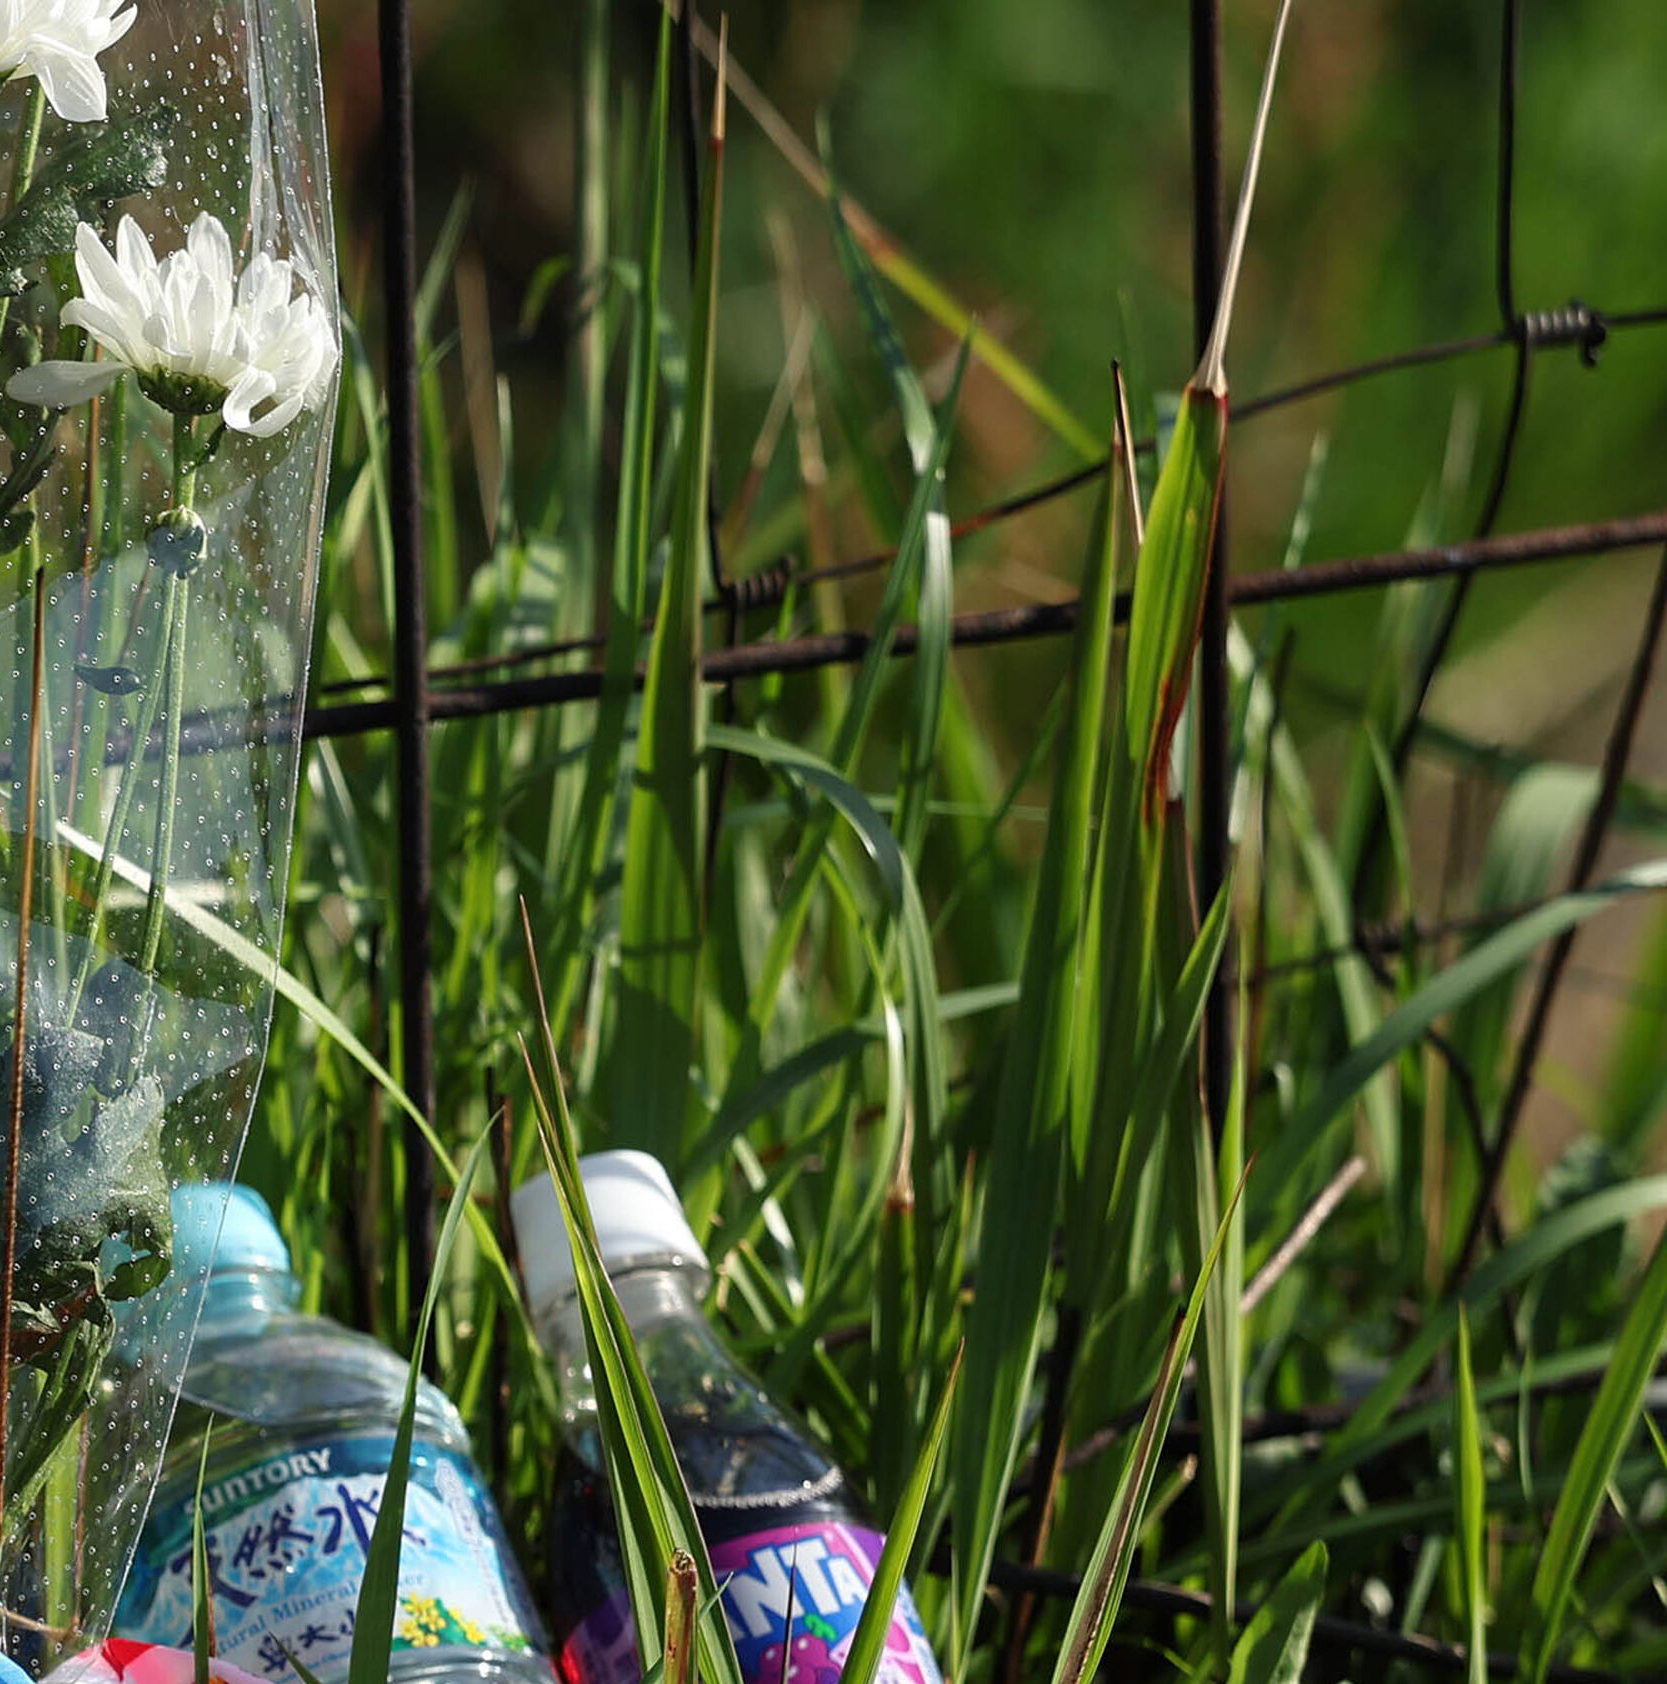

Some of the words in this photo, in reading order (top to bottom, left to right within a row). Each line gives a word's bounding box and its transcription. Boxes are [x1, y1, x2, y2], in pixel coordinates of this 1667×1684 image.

[185, 1448, 334, 1514] SUNTORY
[271, 1581, 357, 1624] Mineral
[721, 1535, 870, 1639] NTA
